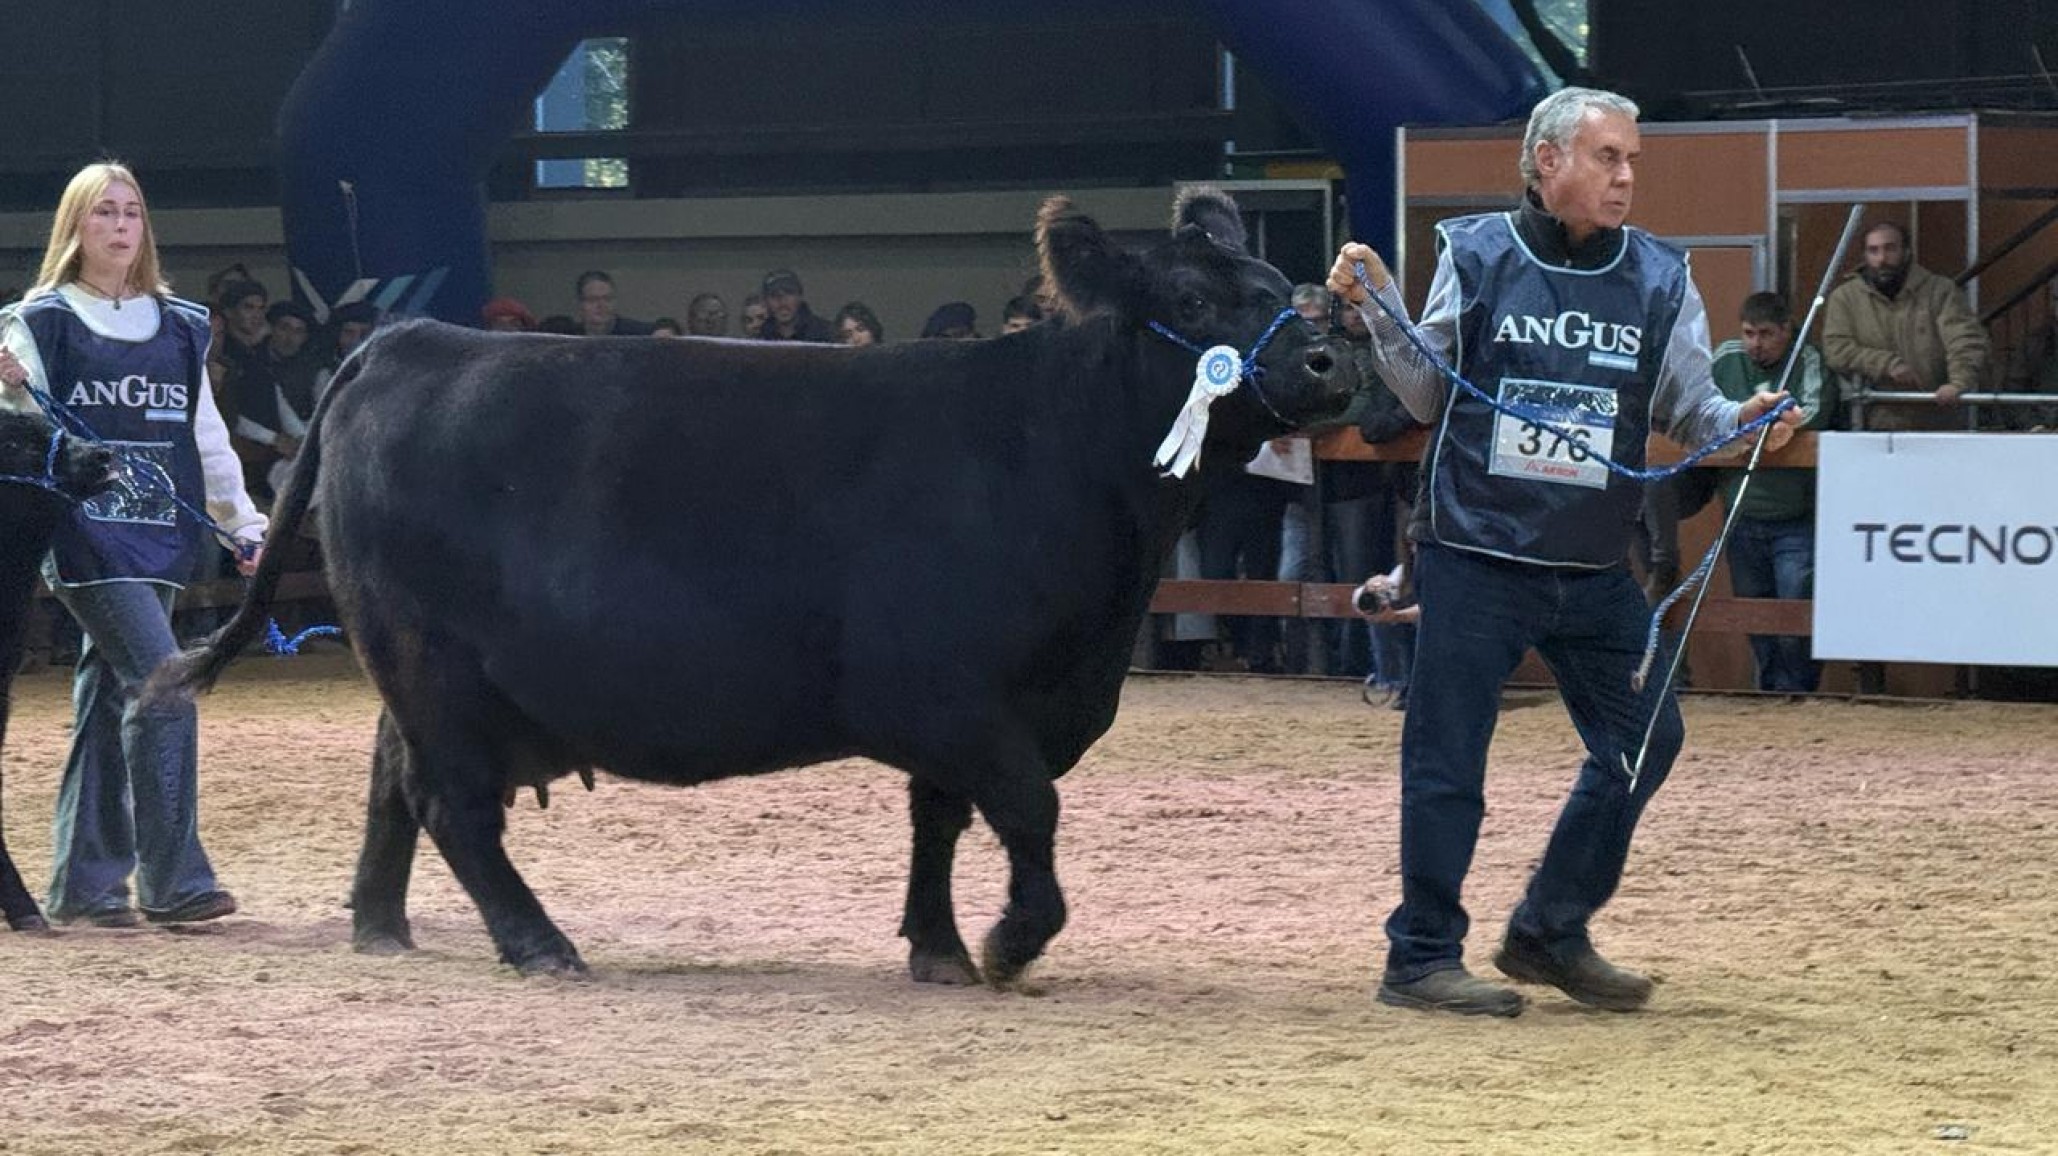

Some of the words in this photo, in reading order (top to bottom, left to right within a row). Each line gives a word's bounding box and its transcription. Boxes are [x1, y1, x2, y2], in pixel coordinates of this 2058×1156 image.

[1493, 310, 1642, 355] ANGUS
[66, 374, 188, 409] ANGUS
[1518, 421, 1591, 462] 376
[1853, 523, 2058, 565] TECNO
